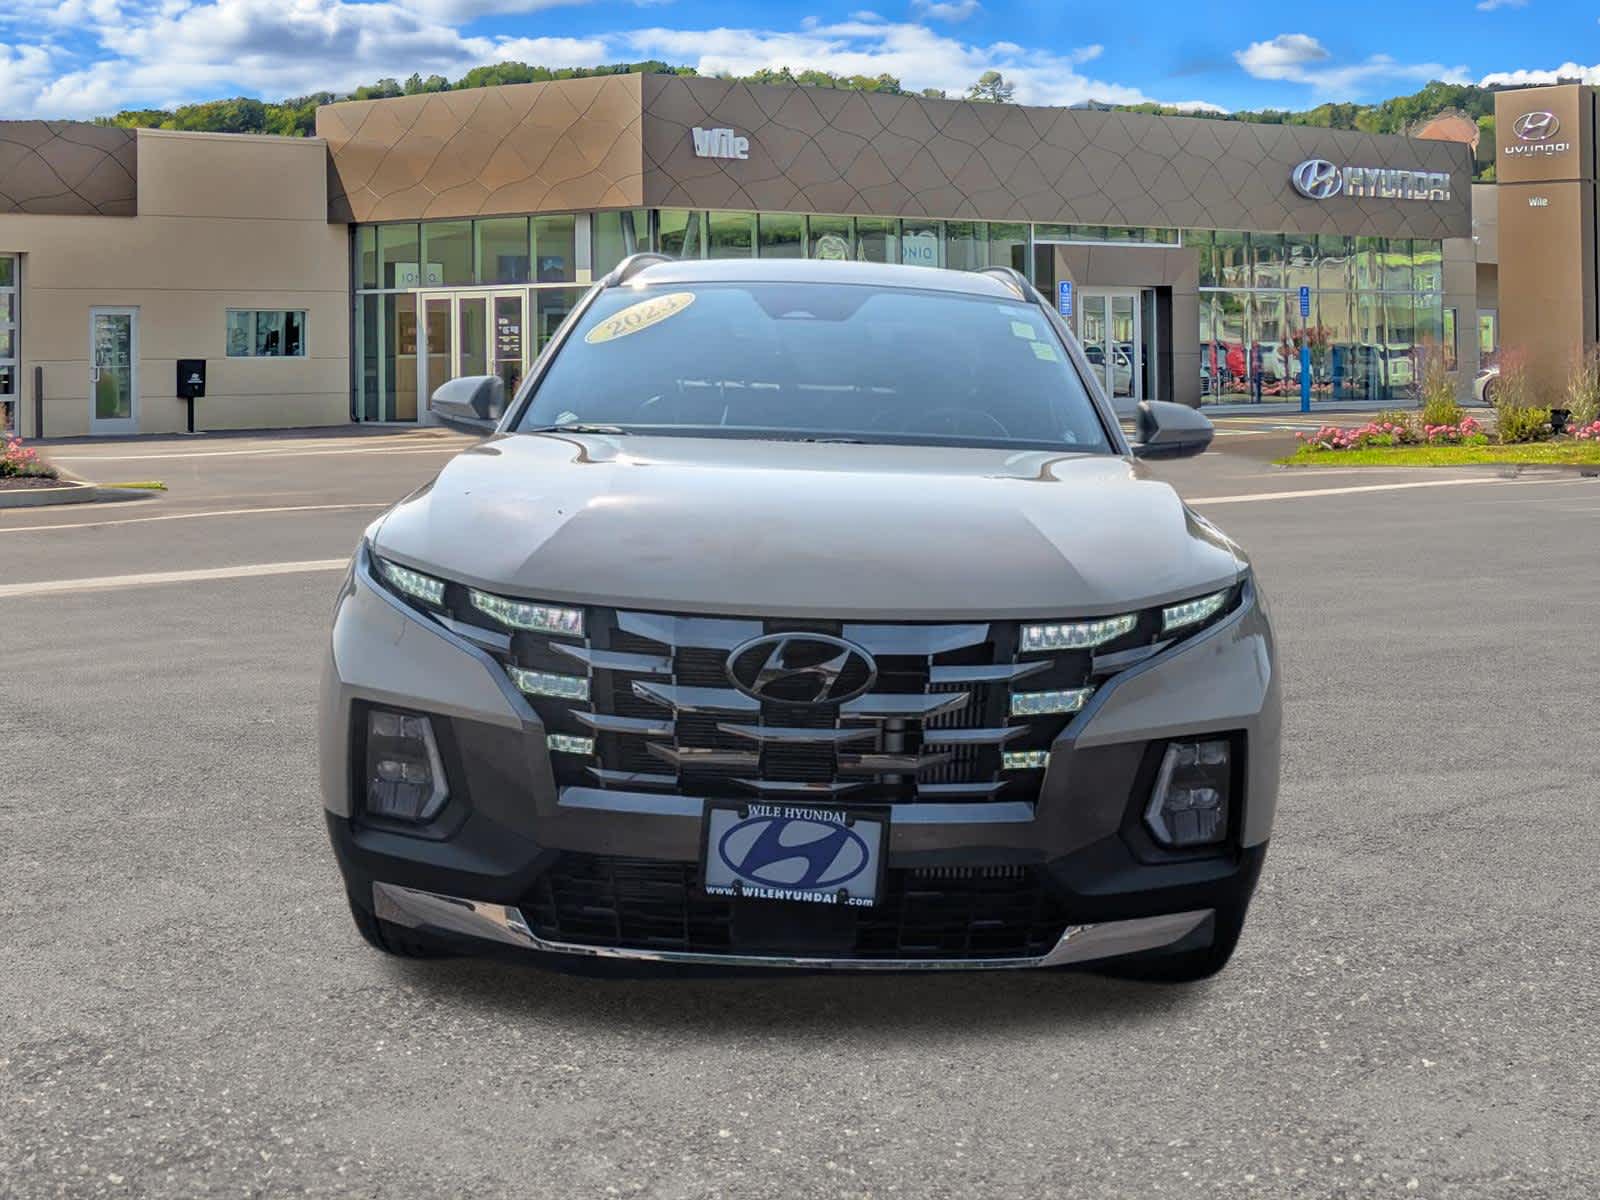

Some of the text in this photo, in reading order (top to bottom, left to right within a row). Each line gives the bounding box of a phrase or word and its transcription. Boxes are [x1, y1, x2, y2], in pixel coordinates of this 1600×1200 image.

[692, 127, 749, 159] Wile
[1343, 167, 1450, 200] HYUNDAI
[1528, 197, 1549, 208] Wile
[747, 804, 848, 823] WILE HYUNDAI
[741, 886, 838, 904] WILEHYUNDAI
